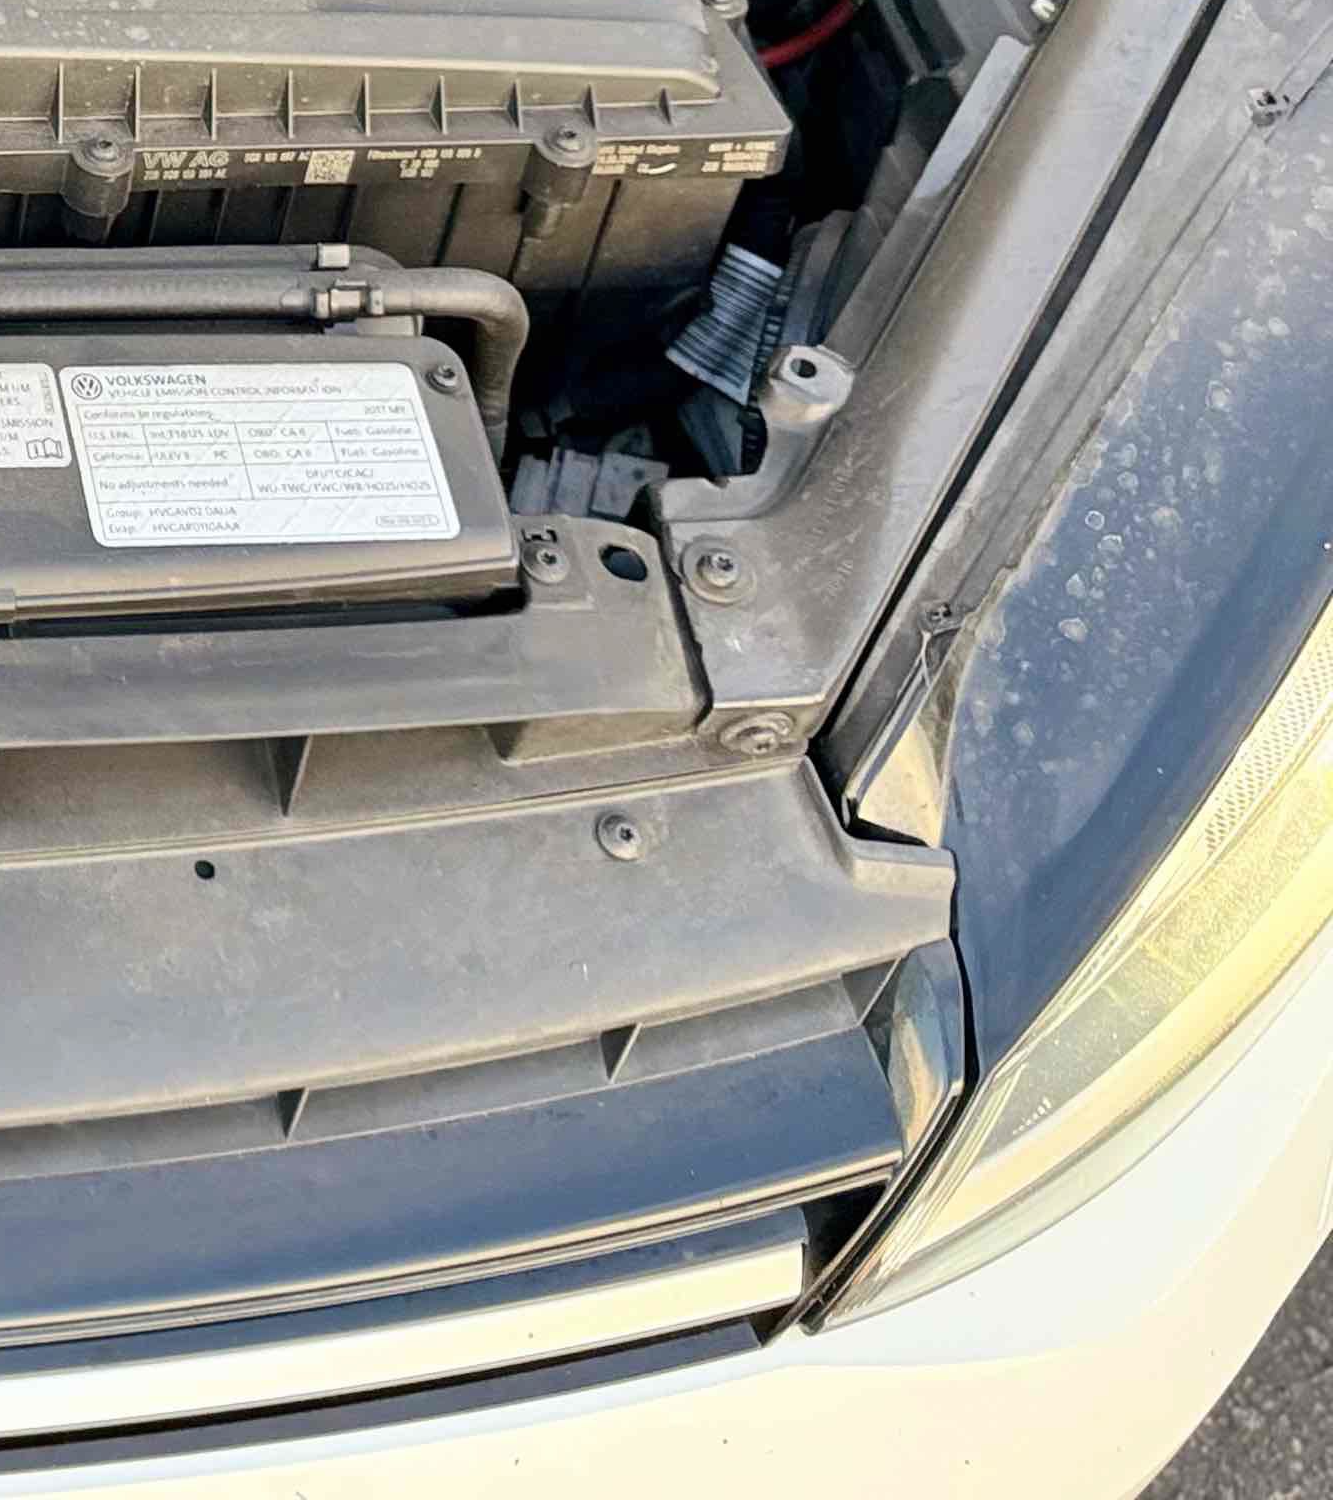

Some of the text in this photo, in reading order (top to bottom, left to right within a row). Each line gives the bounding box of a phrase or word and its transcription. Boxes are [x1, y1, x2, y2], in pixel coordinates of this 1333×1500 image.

[142, 150, 188, 170] VW
[189, 150, 229, 169] AG
[104, 373, 207, 387] VOLKSWAGEN
[365, 426, 413, 436] Gasoline
[372, 446, 420, 457] Gasoline
[98, 477, 228, 493] No adjustments needed
